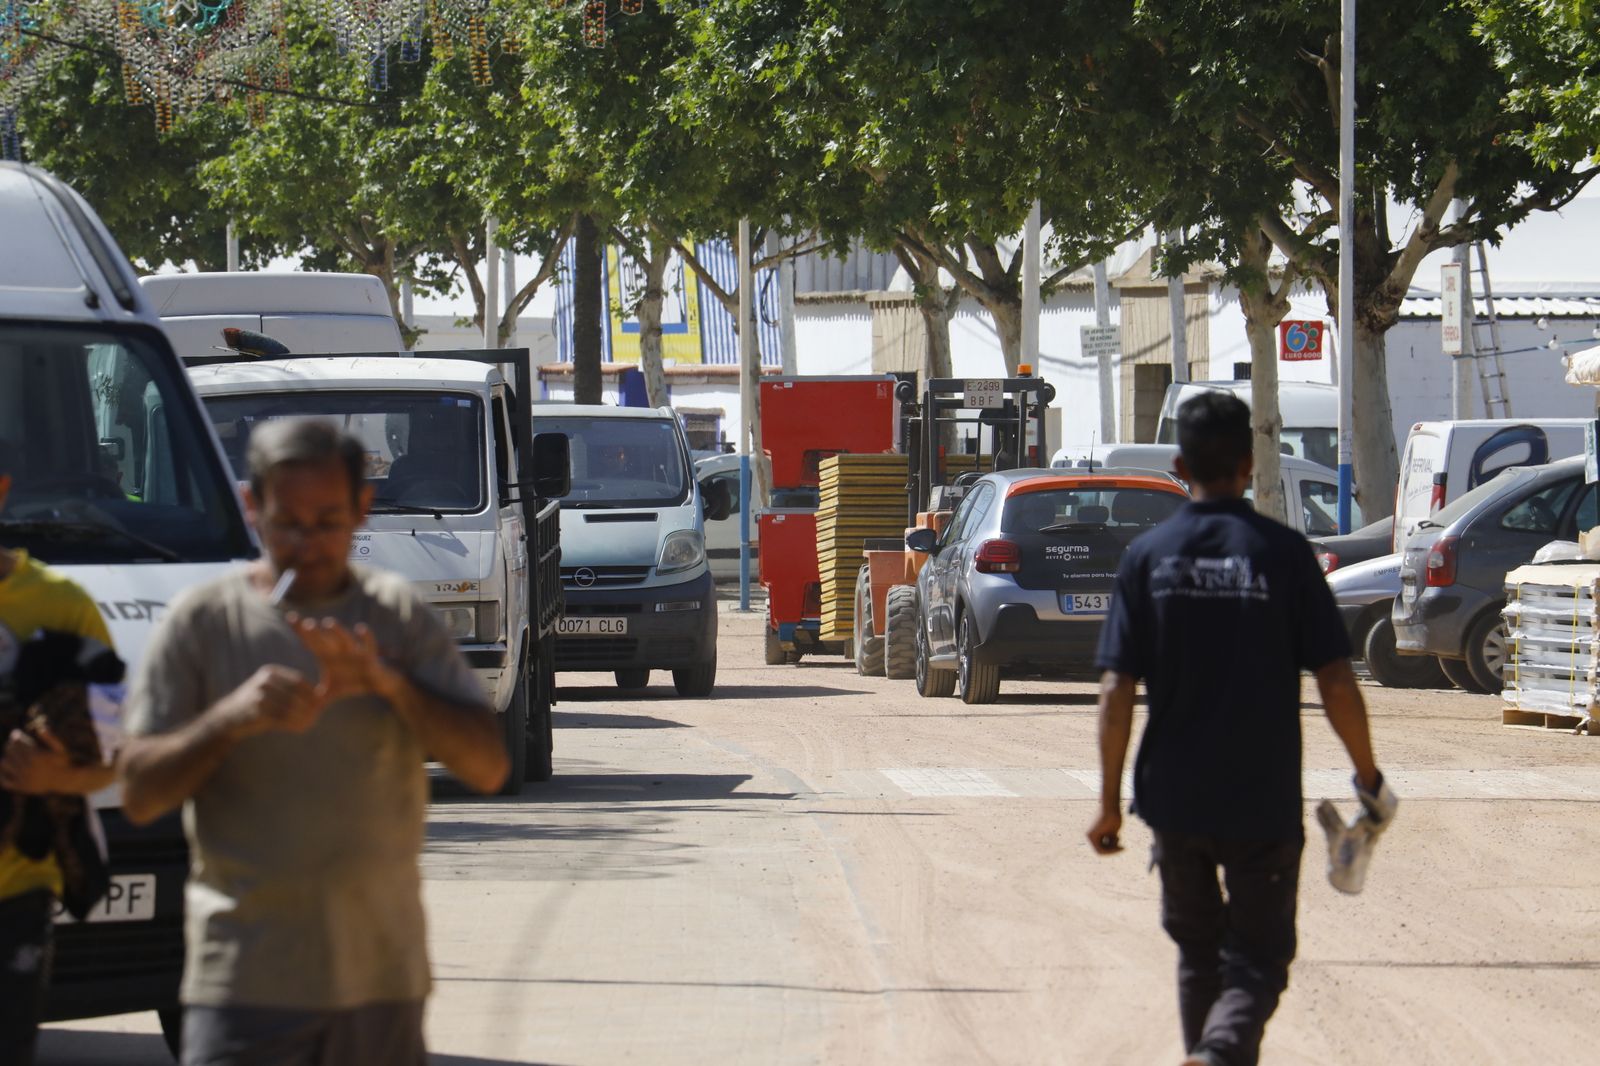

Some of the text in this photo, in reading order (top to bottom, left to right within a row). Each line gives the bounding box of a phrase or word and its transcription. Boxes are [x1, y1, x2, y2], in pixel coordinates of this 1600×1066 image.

[1045, 545, 1089, 555] segurma
[559, 620, 590, 632] 0071
[104, 882, 146, 915] PF
